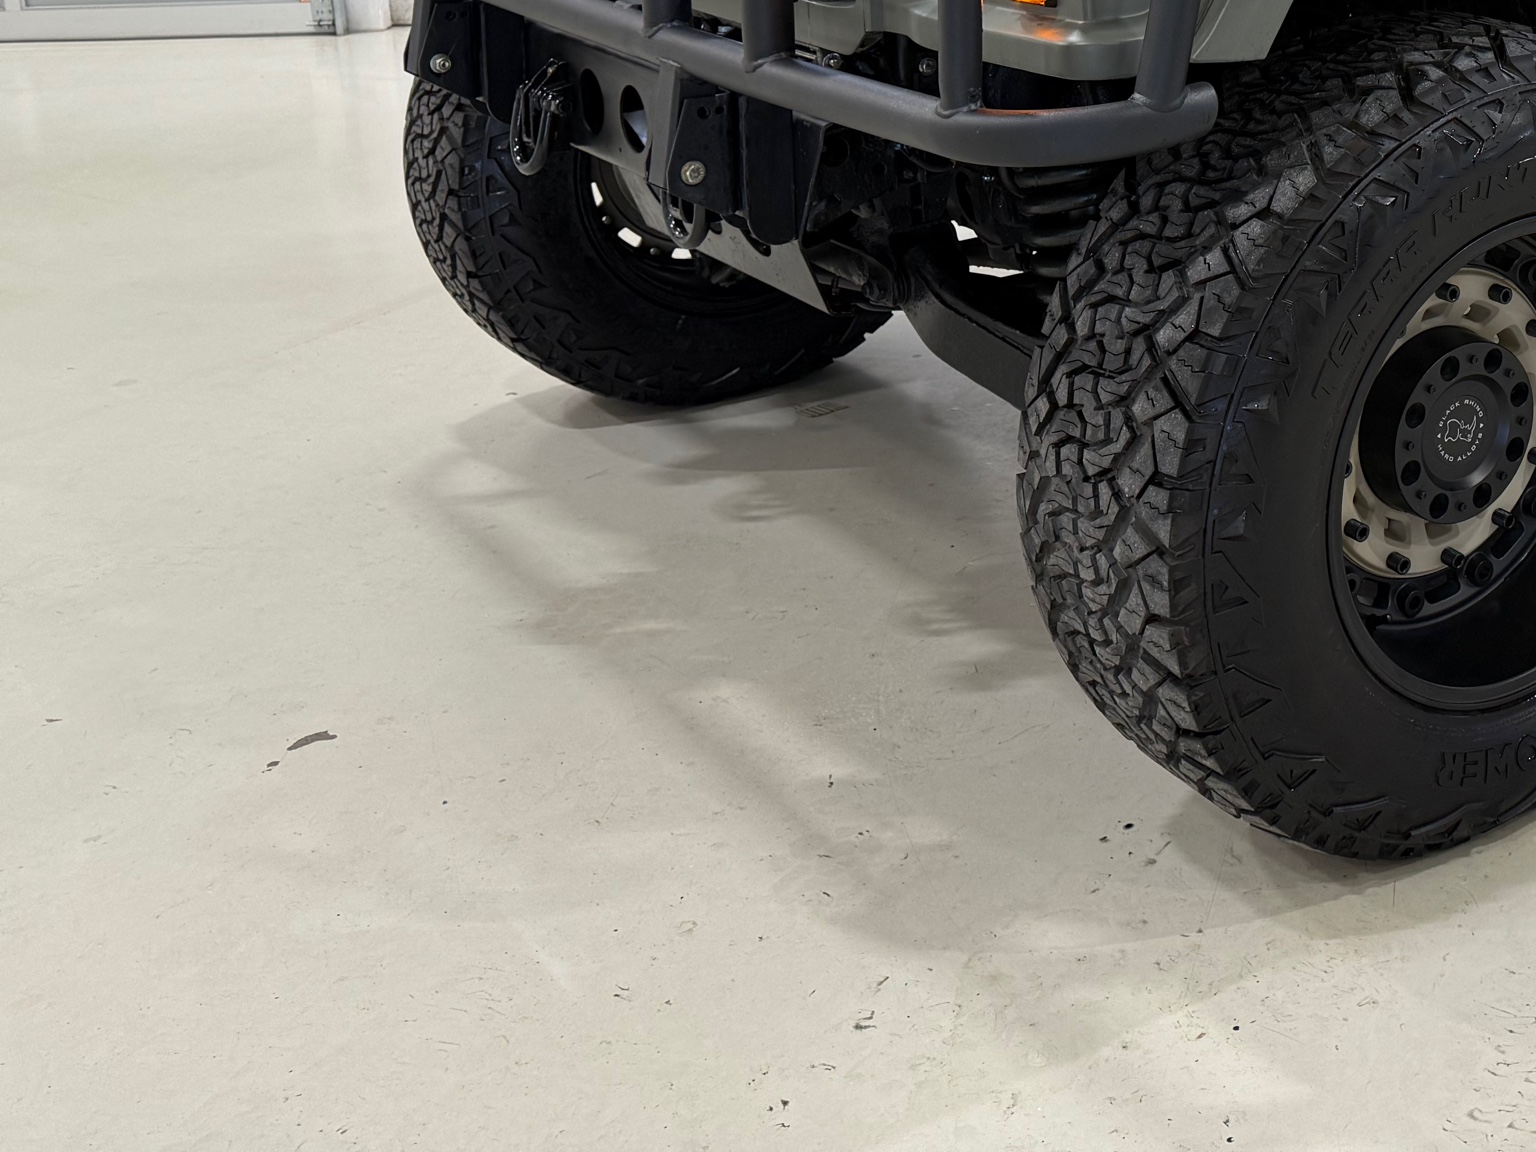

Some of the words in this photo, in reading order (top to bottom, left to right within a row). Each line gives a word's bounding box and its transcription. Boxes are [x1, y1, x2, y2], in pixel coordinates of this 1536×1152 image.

[1438, 401, 1461, 427] BLACK
[1463, 399, 1484, 418] RHINO
[1437, 444, 1454, 462] HARD
[1456, 432, 1483, 462] ALLOYS
